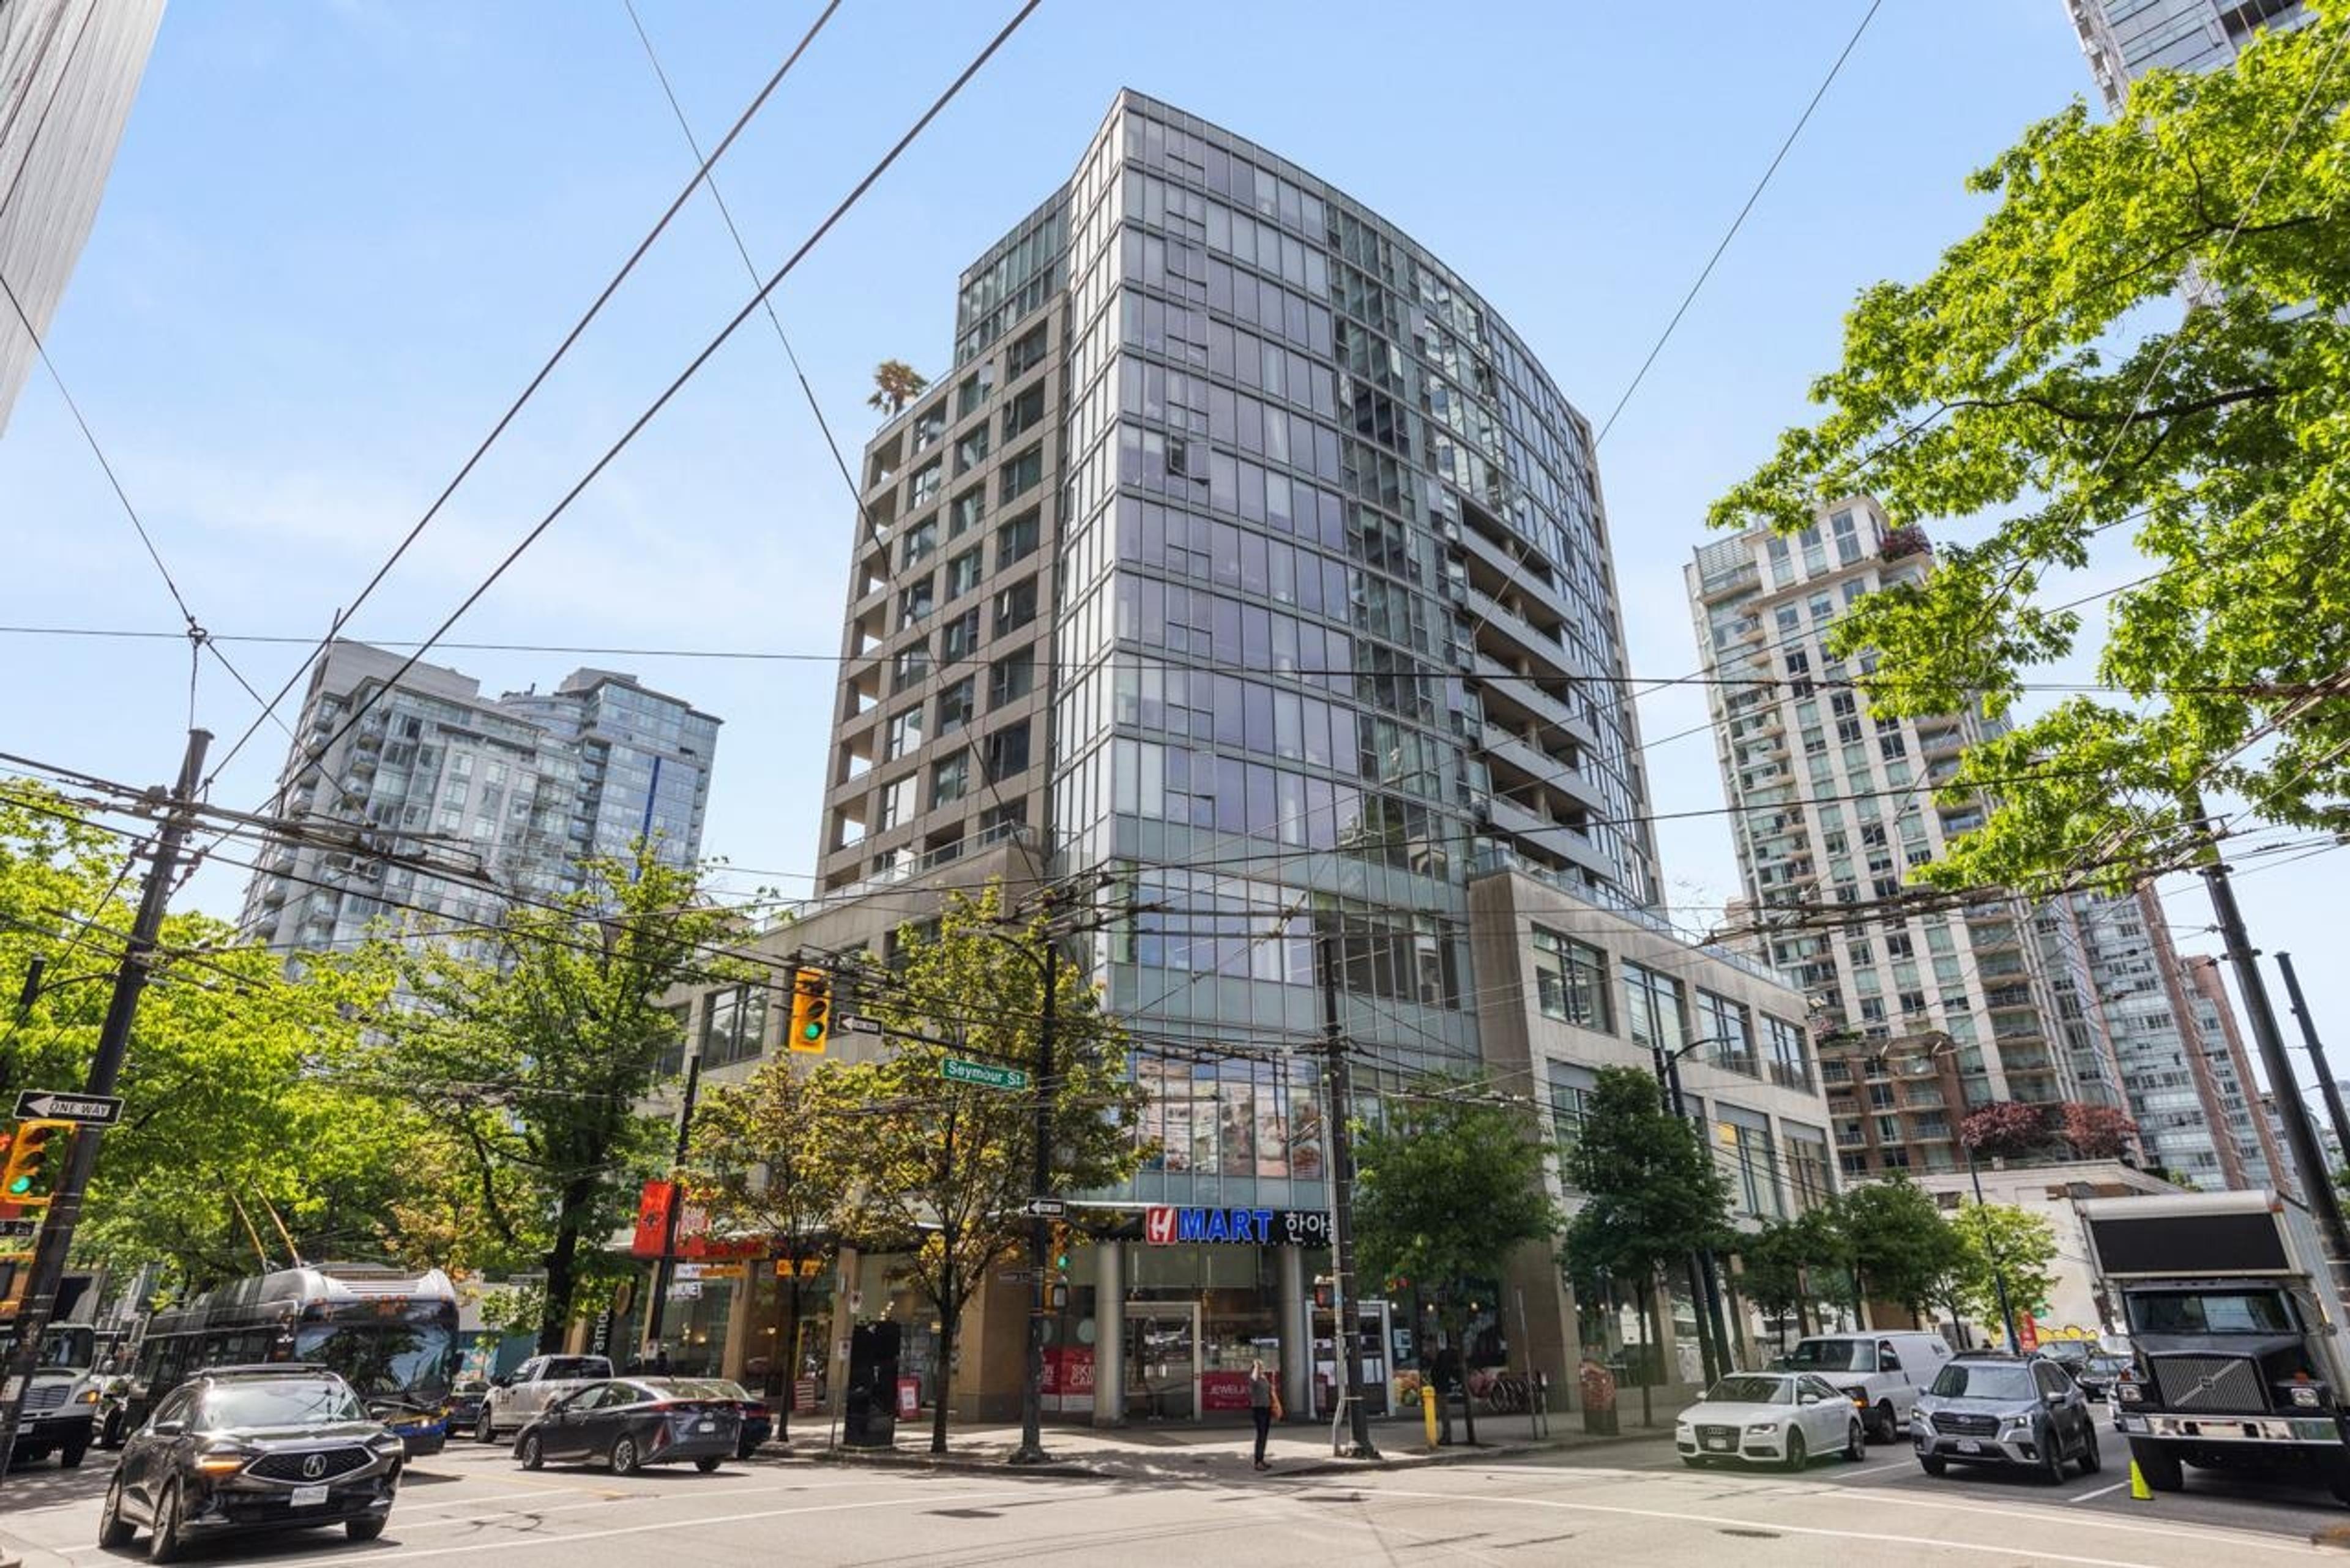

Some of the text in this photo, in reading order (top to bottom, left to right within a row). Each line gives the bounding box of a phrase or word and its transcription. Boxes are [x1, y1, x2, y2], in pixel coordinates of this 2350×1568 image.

[948, 1061, 1021, 1086] Seymour St
[49, 1102, 109, 1116] ONE WAY
[1151, 1208, 1174, 1242] H
[1178, 1208, 1273, 1241] MART
